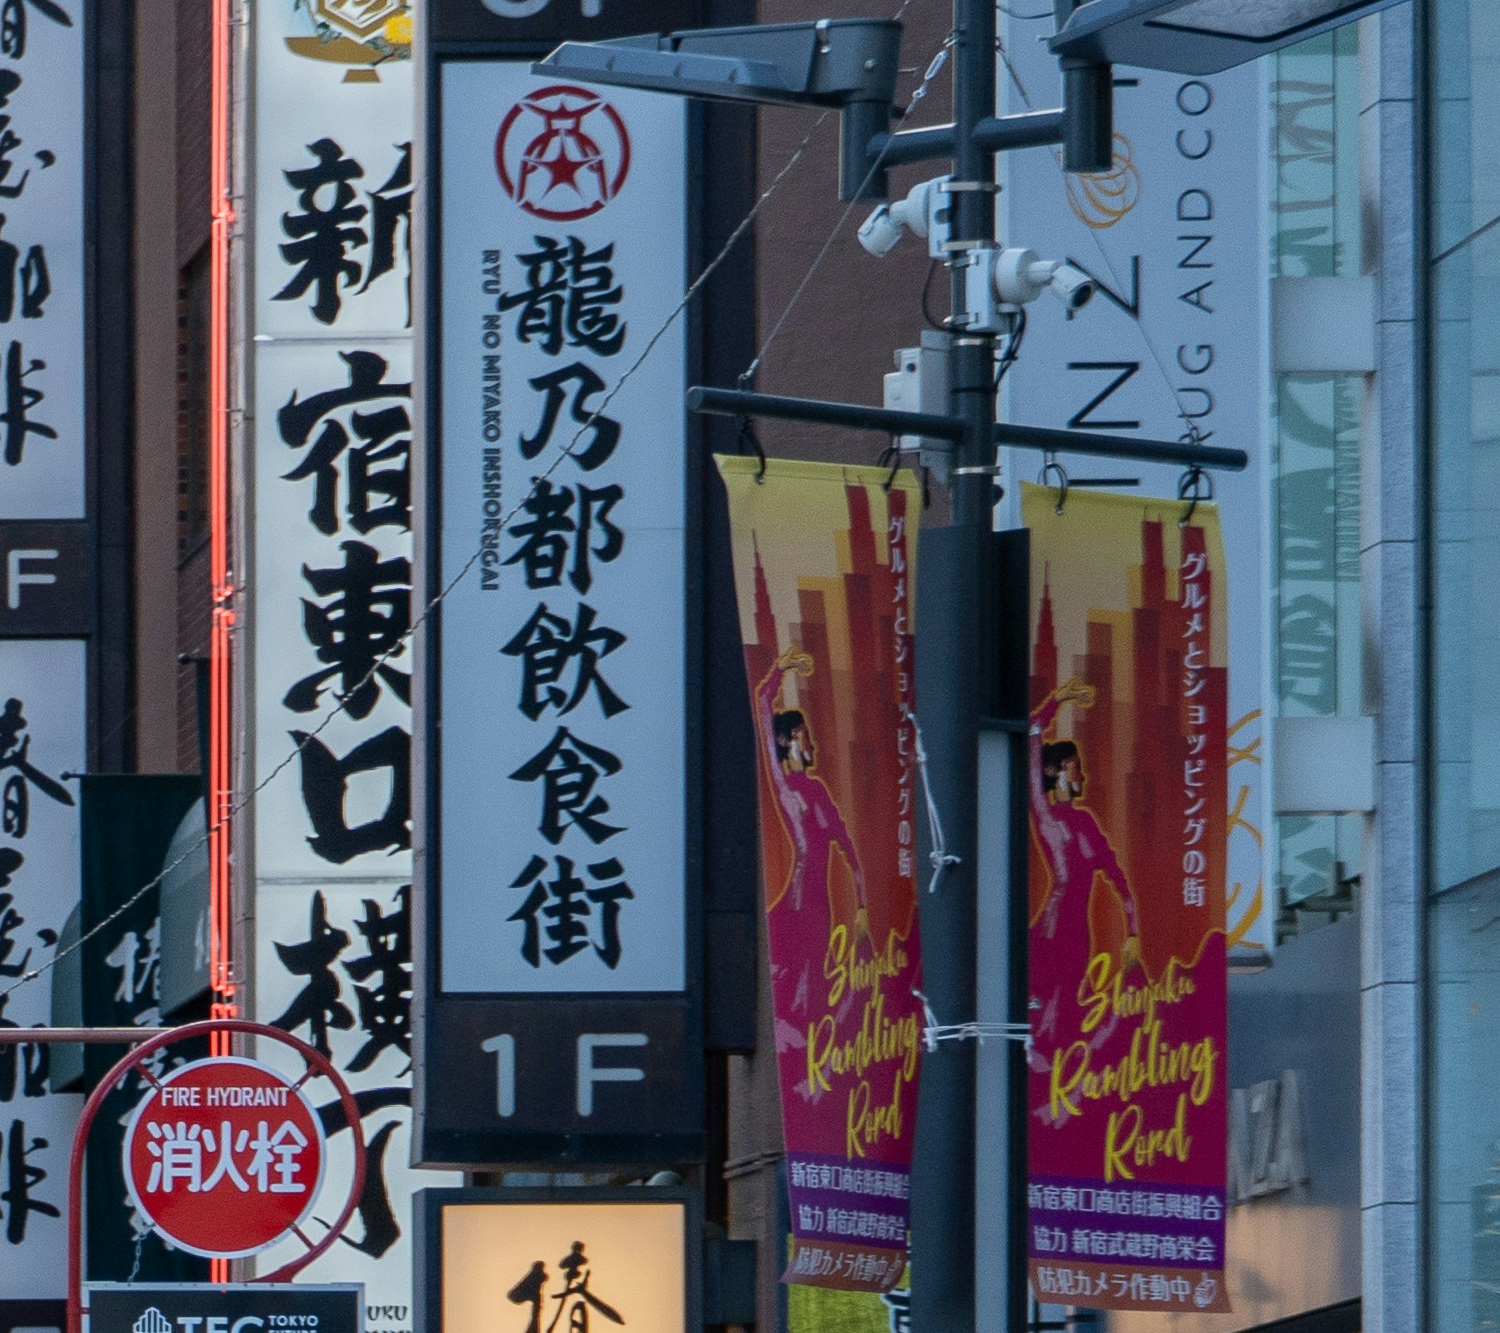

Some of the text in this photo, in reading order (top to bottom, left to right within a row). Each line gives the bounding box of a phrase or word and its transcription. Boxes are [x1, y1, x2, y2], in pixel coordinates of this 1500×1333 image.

[1177, 70, 1214, 161] CO
[480, 249, 502, 294] RYU
[1177, 187, 1214, 313] AND
[480, 314, 502, 348] NO
[480, 354, 502, 446] MIYAKO
[496, 233, 635, 970] 龍乃都飲食街
[1180, 550, 1208, 908] グルメとショッピングの街
[480, 1032, 650, 1118] 1F
[806, 1000, 920, 1095] Rambling
[1049, 1020, 1218, 1120] Rambling
[161, 1086, 290, 1108] FIRE HYDRANT
[144, 1120, 308, 1196] 消火栓
[1028, 1184, 1224, 1222] 新宿東口商店街振興組合
[1033, 1225, 1218, 1263] 協力 新宿武蔵野商栄会
[267, 1315, 318, 1327] TOKYO
[1037, 1267, 1192, 1304] 防犯カメラ作動中
